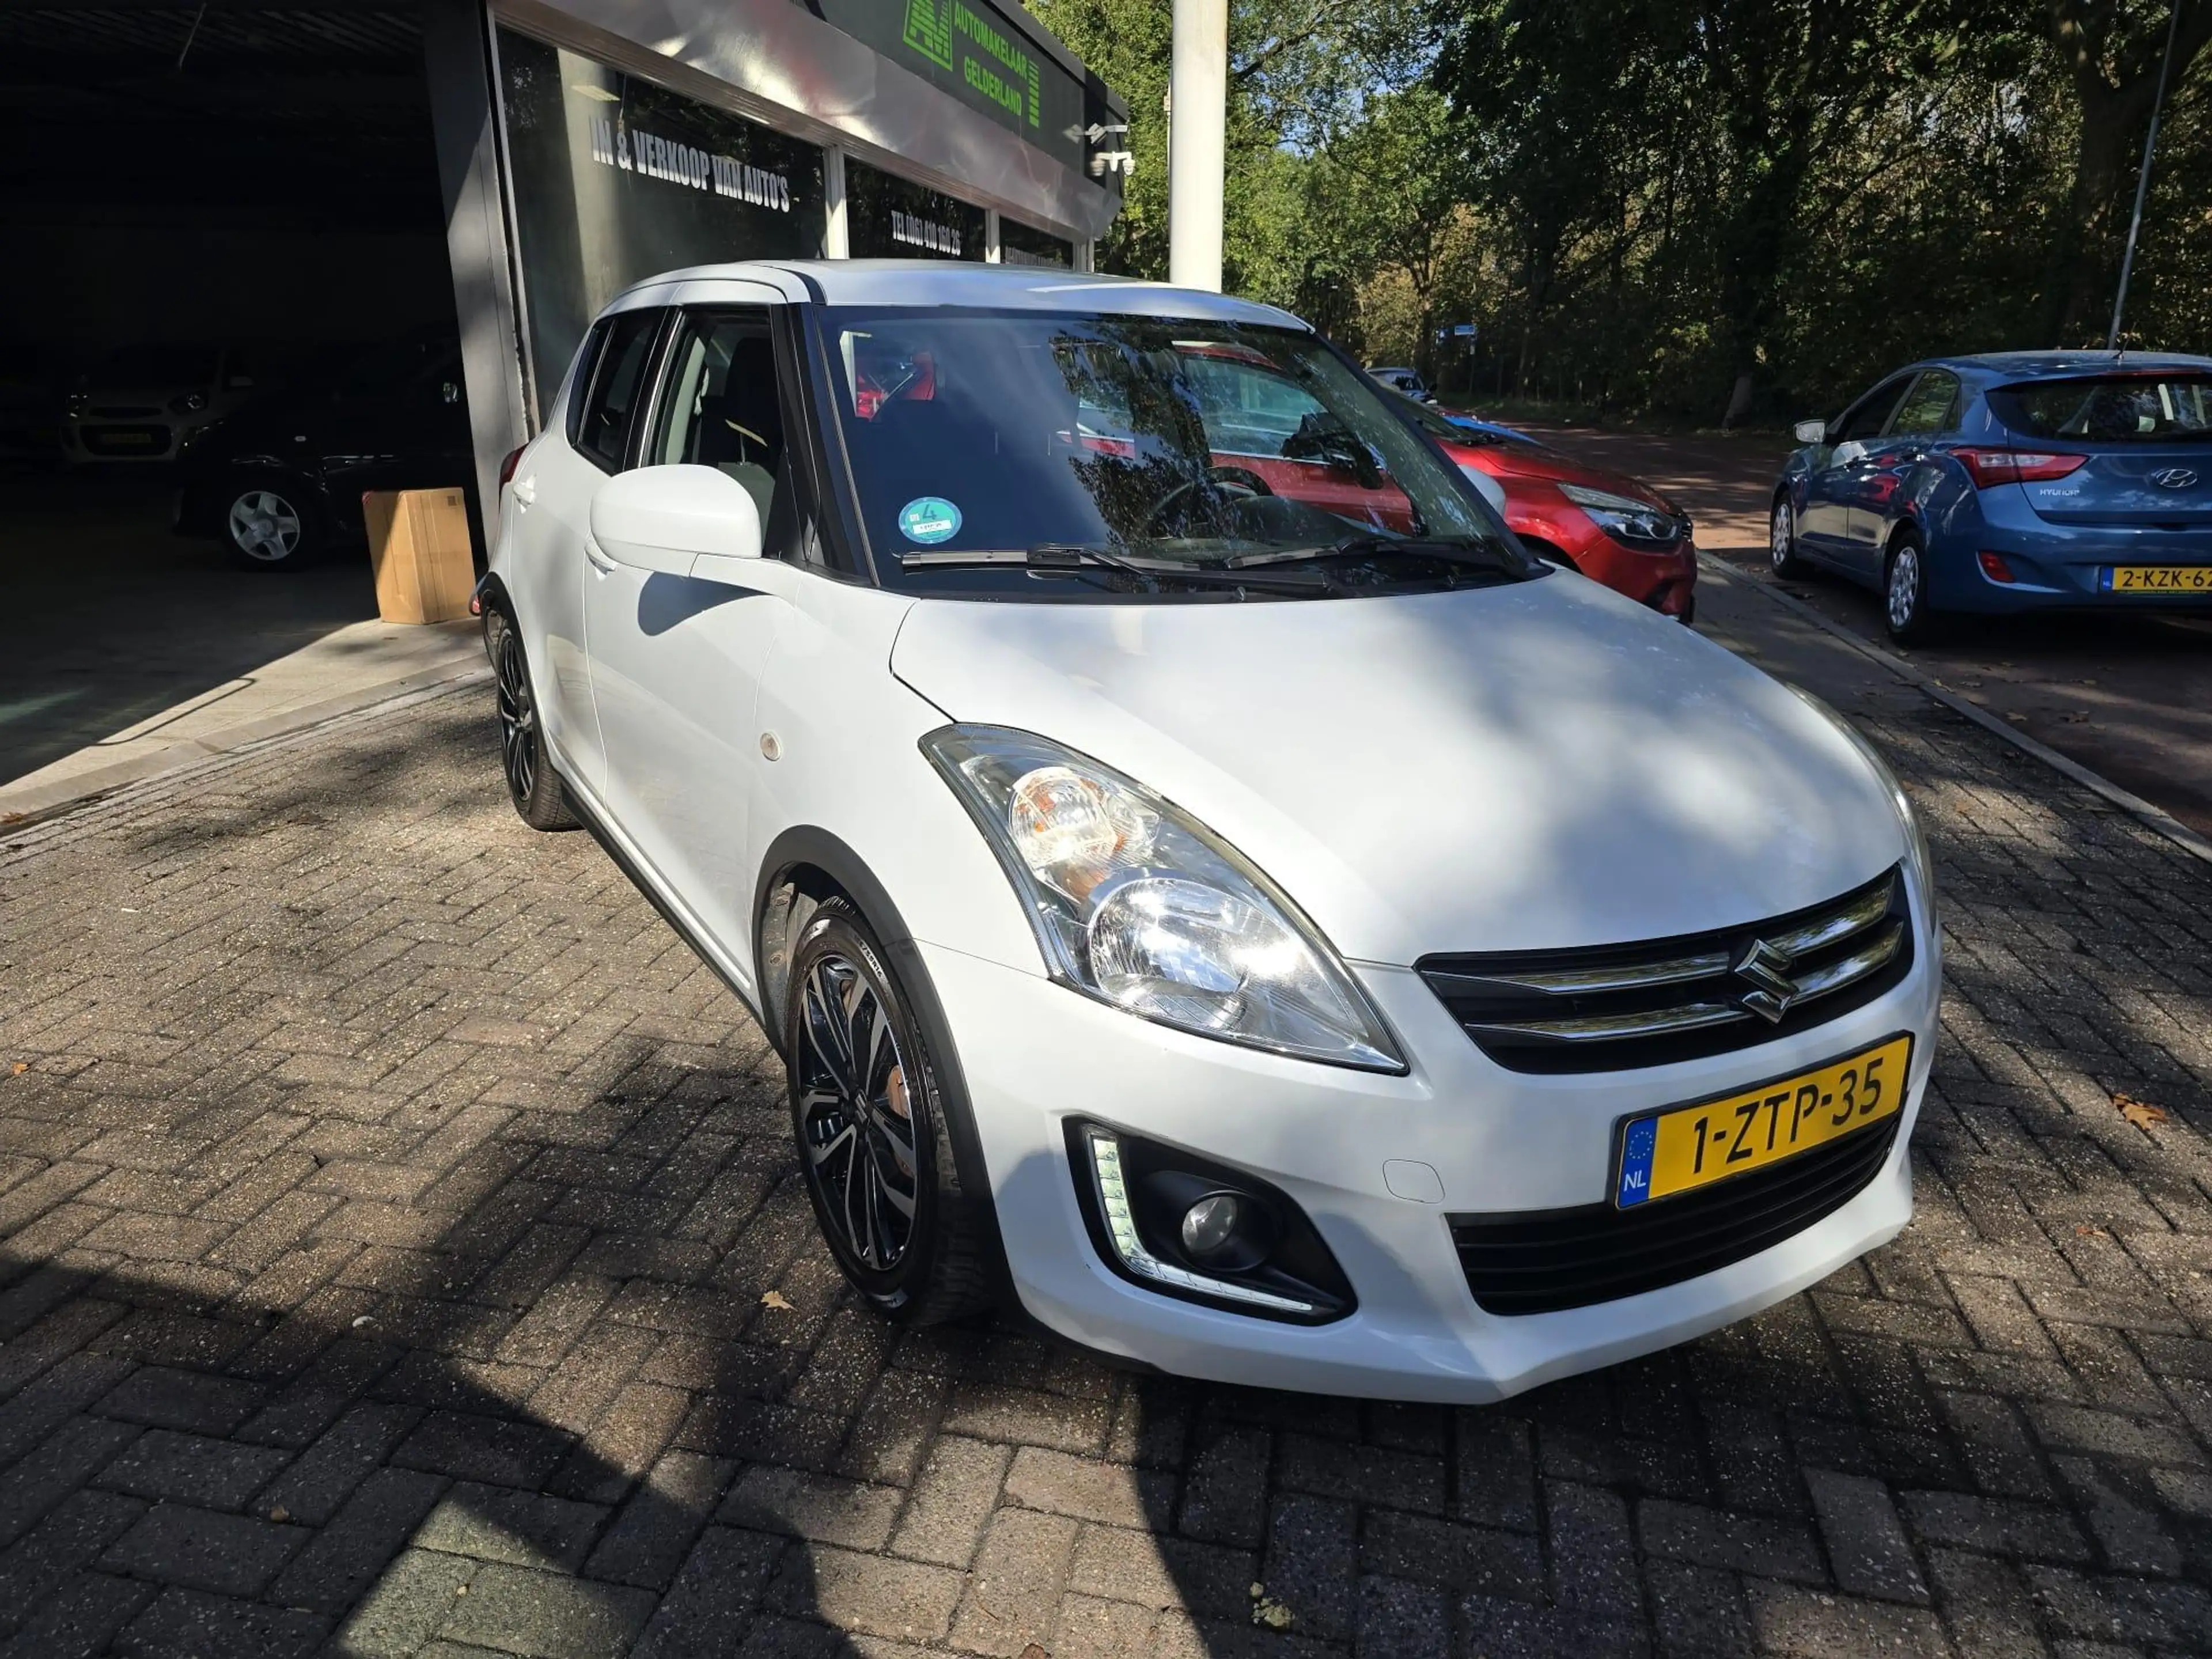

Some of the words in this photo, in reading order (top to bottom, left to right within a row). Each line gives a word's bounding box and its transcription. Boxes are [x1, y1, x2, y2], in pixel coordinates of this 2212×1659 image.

[955, 1, 1028, 80] AUTOMAKELAAR
[964, 56, 1021, 116] GELDERLAND
[591, 117, 613, 165] IN
[617, 132, 632, 171] &
[632, 130, 710, 191] VERKOOP
[711, 154, 743, 200] VAN
[744, 165, 790, 213] AUTO'S
[891, 210, 906, 242] TEL
[922, 503, 937, 520] 4
[1692, 1057, 1884, 1174] 1-ZTP-35
[1623, 1169, 1646, 1192] NL
